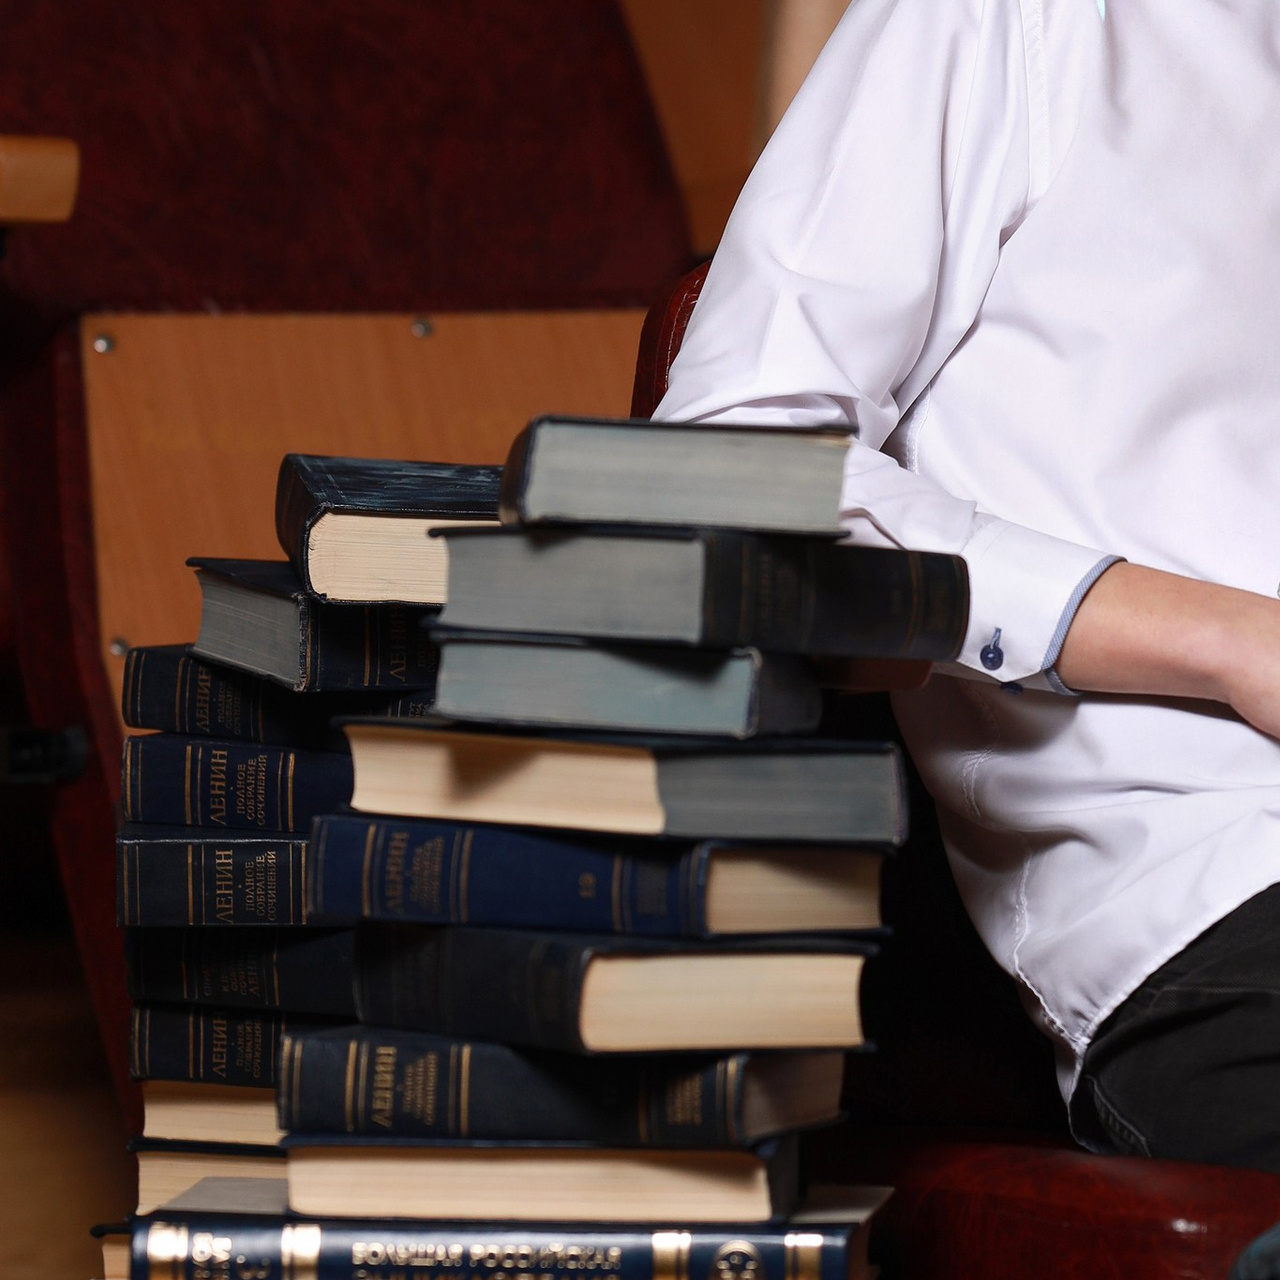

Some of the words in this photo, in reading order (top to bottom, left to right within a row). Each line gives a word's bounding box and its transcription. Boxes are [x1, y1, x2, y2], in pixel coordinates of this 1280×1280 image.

[209, 748, 229, 827] ЛЕНИН
[236, 762, 247, 816] ПОЛНОЕ
[246, 757, 258, 822] СОБРАНИЕ
[257, 753, 269, 827] СОЧИНЕНИЙ
[215, 849, 234, 926] ЛЕНИН
[245, 859, 255, 913] ПОЛНОЕ
[255, 854, 266, 917] СОБРАНИЕ
[266, 849, 277, 922] СОЧИНЕНИЙ
